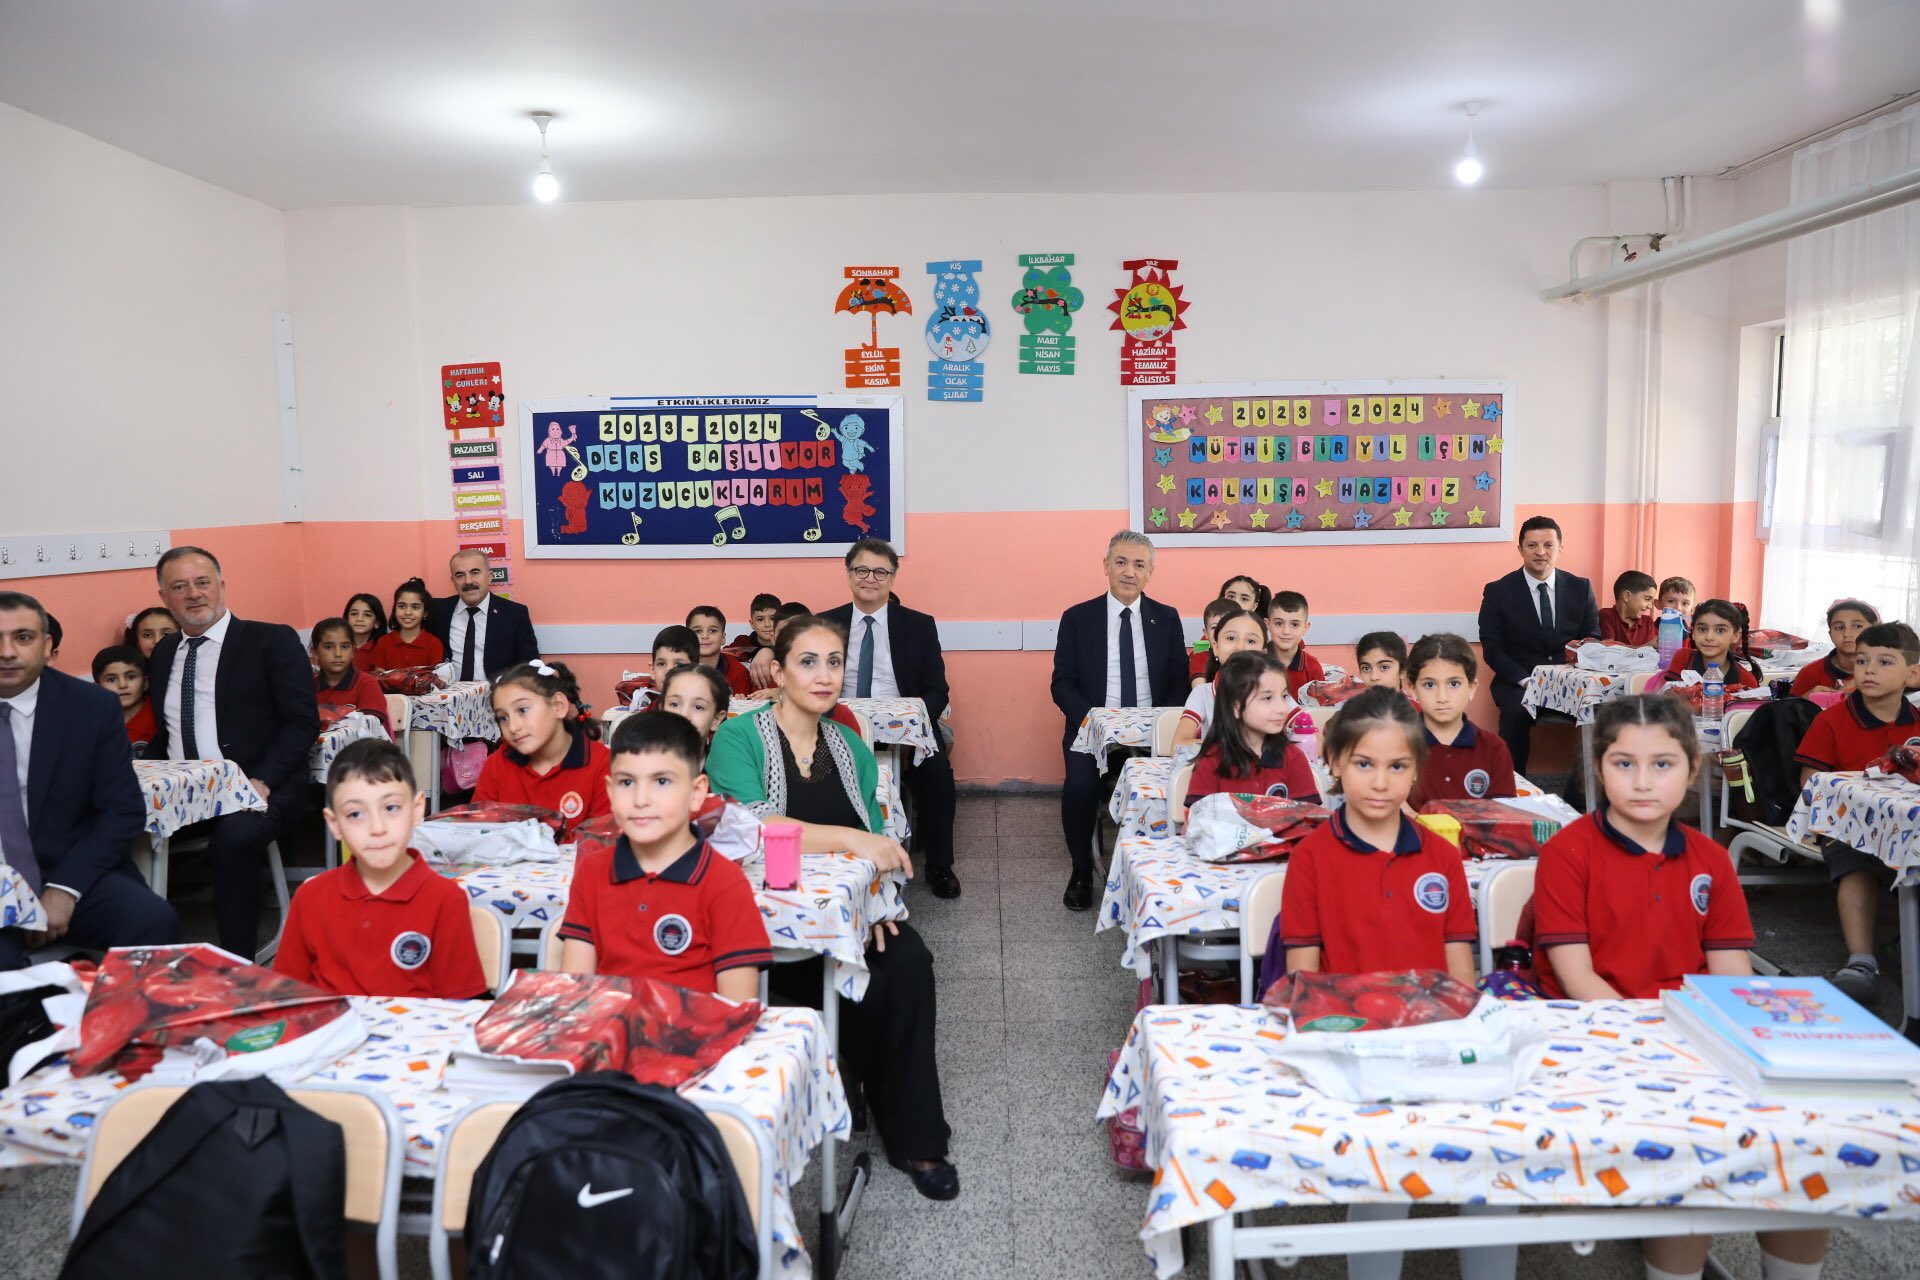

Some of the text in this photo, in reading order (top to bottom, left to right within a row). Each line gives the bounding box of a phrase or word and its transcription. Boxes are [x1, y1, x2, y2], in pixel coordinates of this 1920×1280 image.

[1028, 255, 1065, 264] İLKBAHAR
[949, 262, 962, 271] KIŞ
[851, 269, 894, 277] SONBAHAR
[1036, 336, 1060, 345] MART
[861, 349, 885, 358] EYLÜL
[1035, 349, 1061, 358] NİSAN
[1131, 347, 1168, 356] HAZİRAN
[864, 363, 885, 373] EKİM
[942, 363, 971, 372] ARALIK
[1036, 364, 1061, 373] MAYIS
[1133, 361, 1168, 370] TEMMUZ
[450, 367, 485, 377] HAFTANIN
[455, 377, 488, 388] GÜNLERİ
[864, 377, 890, 386] KASIM
[944, 377, 968, 386] OCAK
[1132, 374, 1171, 384] AĞUSTOS
[943, 391, 968, 400] ŞUBAT
[657, 398, 770, 407] ETKİNLİKLERİMİZ
[453, 442, 495, 455] PAZARTESİ
[1191, 436, 1484, 461] MÜTHİŞ BİR YIL İÇİN
[591, 446, 831, 470] DERS BAŞLIYOR
[467, 470, 485, 480] SALI
[602, 483, 822, 503] KUZUCUKLARIM
[1190, 482, 1456, 502] KALKIŞA HAZIRIZ
[457, 494, 501, 506] ÇARŞAMBA
[460, 519, 501, 531] PERŞEMBE
